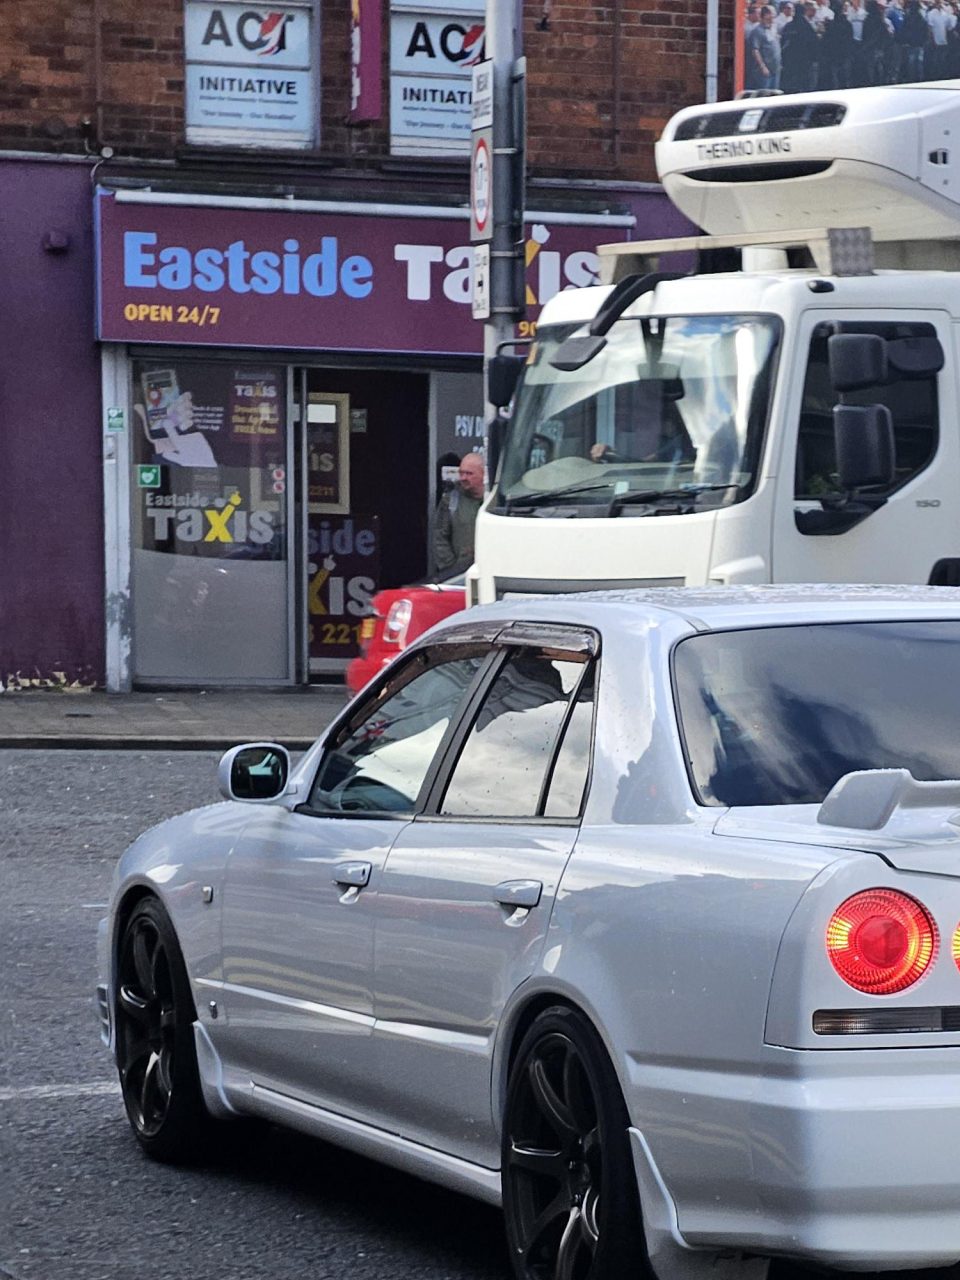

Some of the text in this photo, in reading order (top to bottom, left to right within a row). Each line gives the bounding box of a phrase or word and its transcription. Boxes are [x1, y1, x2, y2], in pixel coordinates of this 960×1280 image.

[202, 9, 295, 55] ACT
[199, 76, 298, 95] INITIATIVE
[403, 87, 473, 105] INITIATI
[696, 137, 792, 160] THERMO KING
[123, 231, 374, 299] Eastside
[123, 303, 221, 326] OPEN 24/7
[145, 491, 210, 508] Eastside
[147, 501, 274, 544] Taxis
